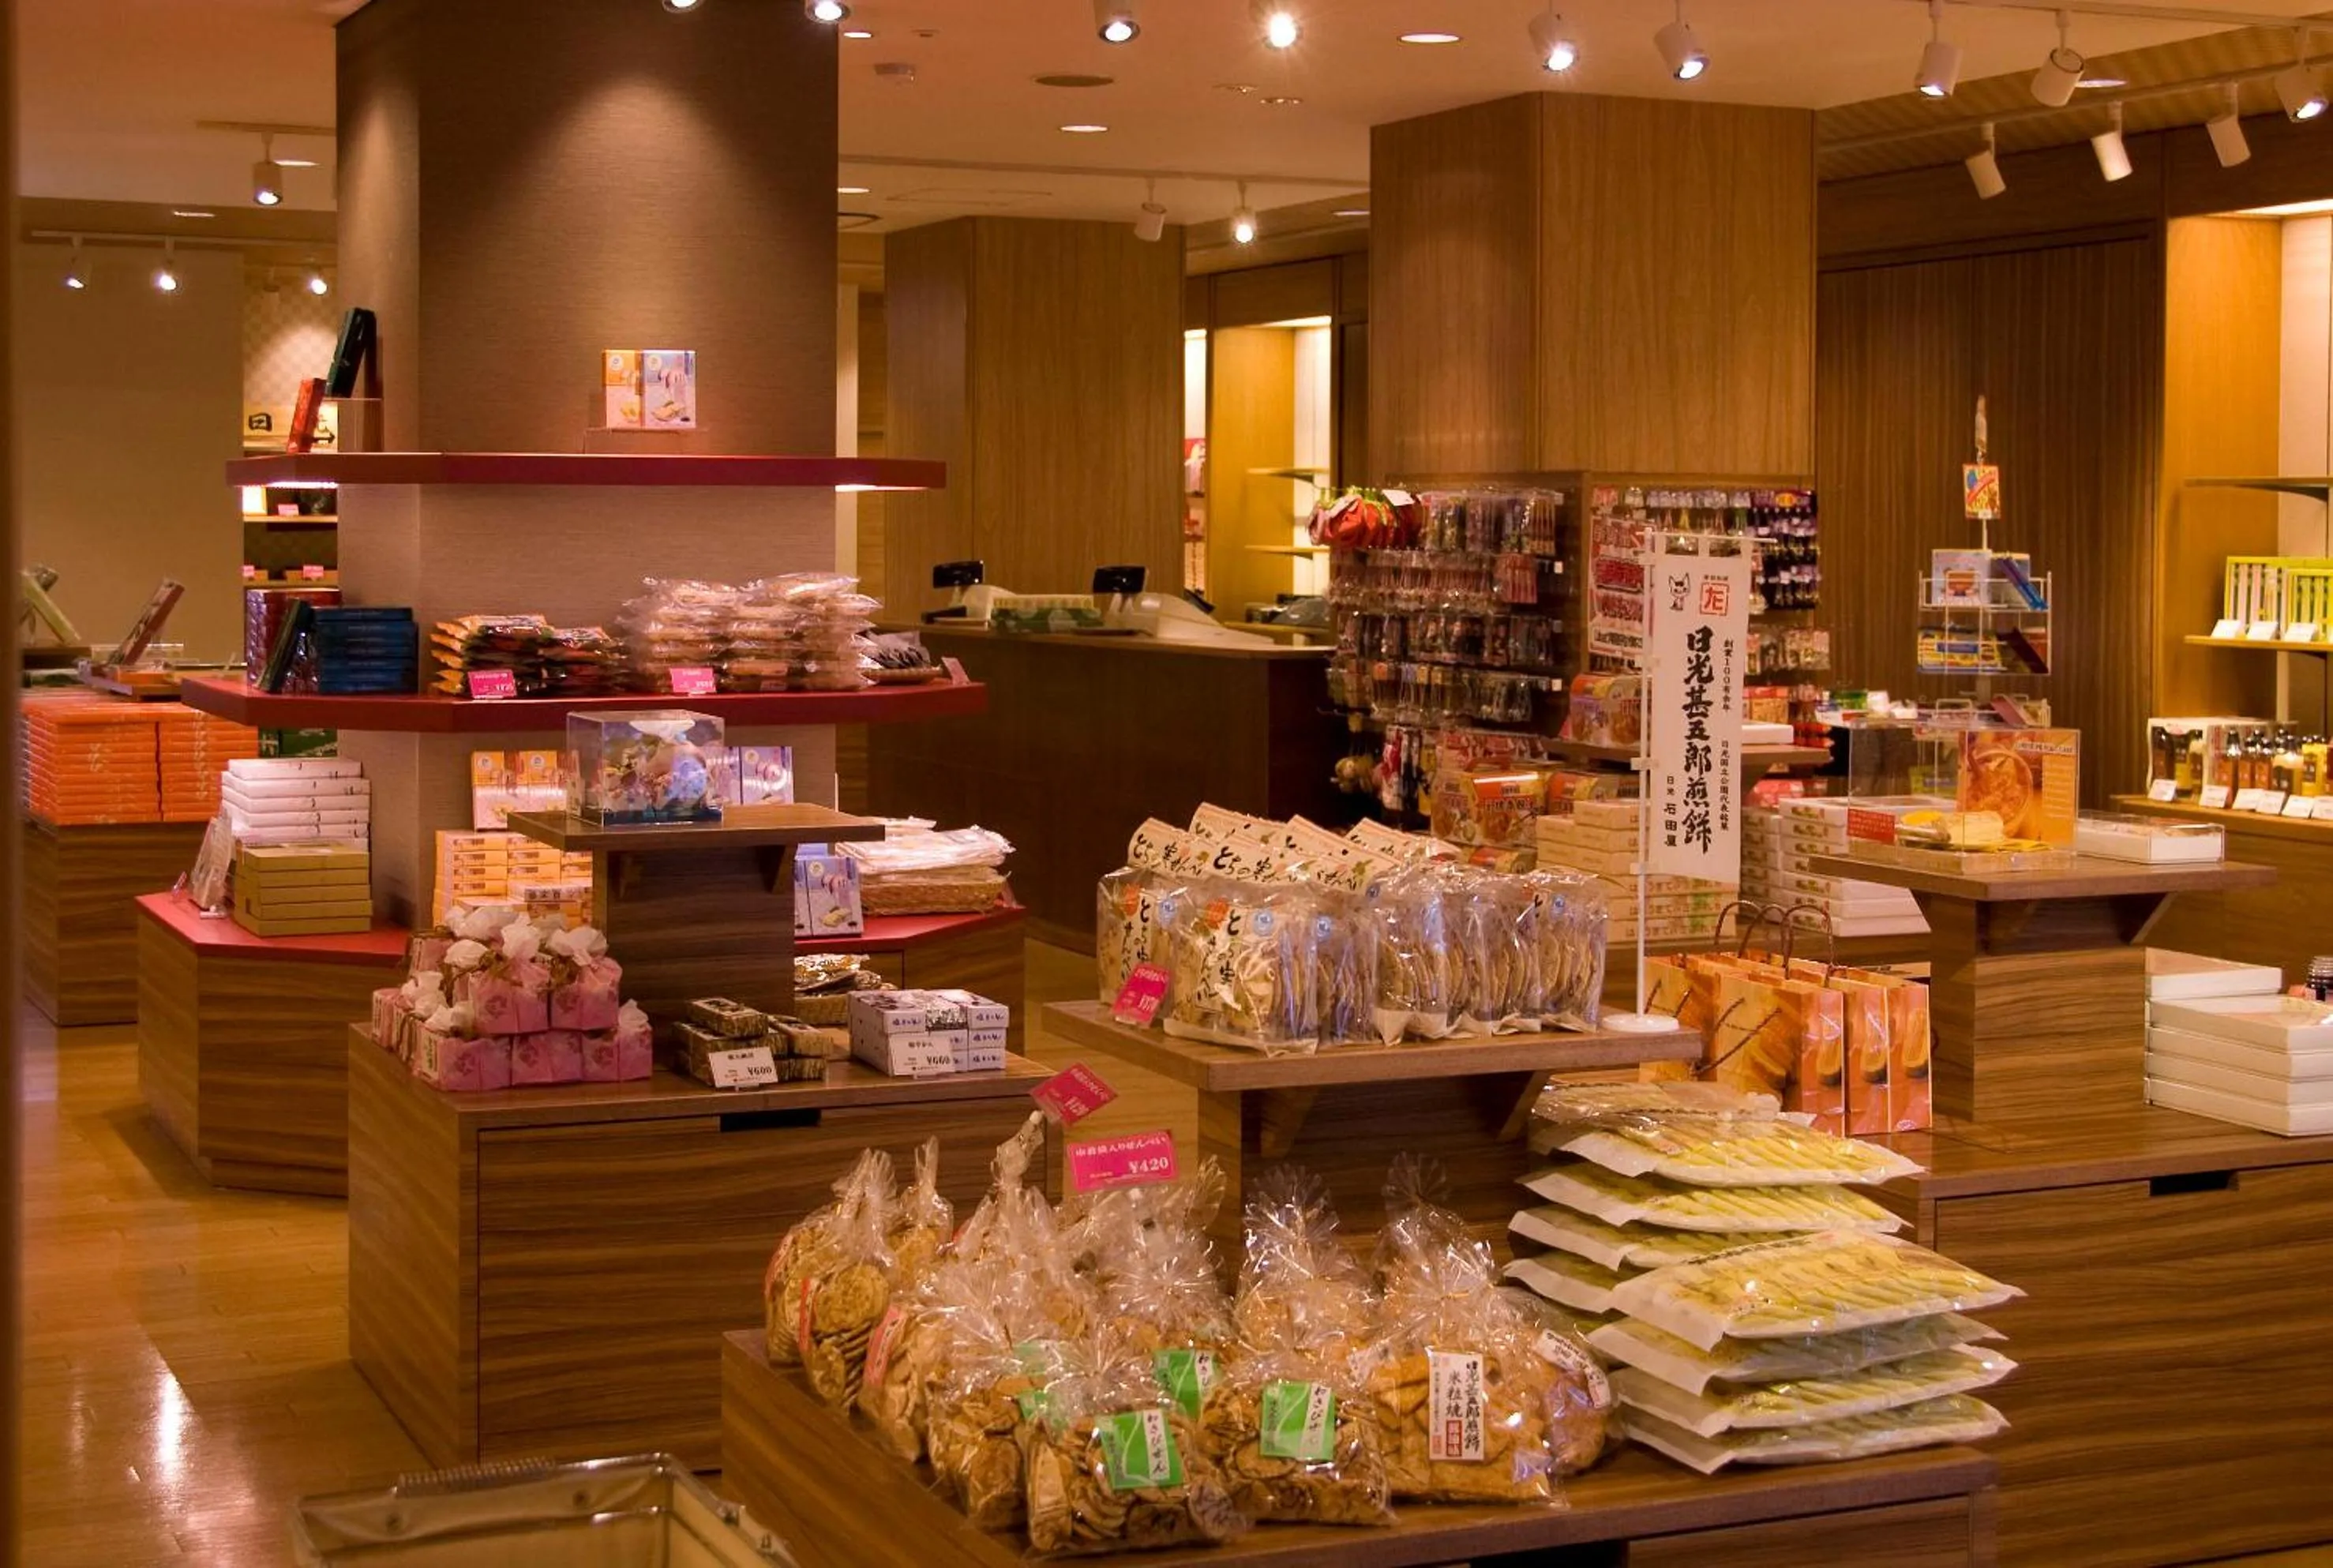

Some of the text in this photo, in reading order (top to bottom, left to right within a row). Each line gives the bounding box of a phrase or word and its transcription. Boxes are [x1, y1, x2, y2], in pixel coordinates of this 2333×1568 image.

[1682, 625, 1714, 855] 日光甚五郎煎餅
[1128, 1157, 1168, 1173] ¥420
